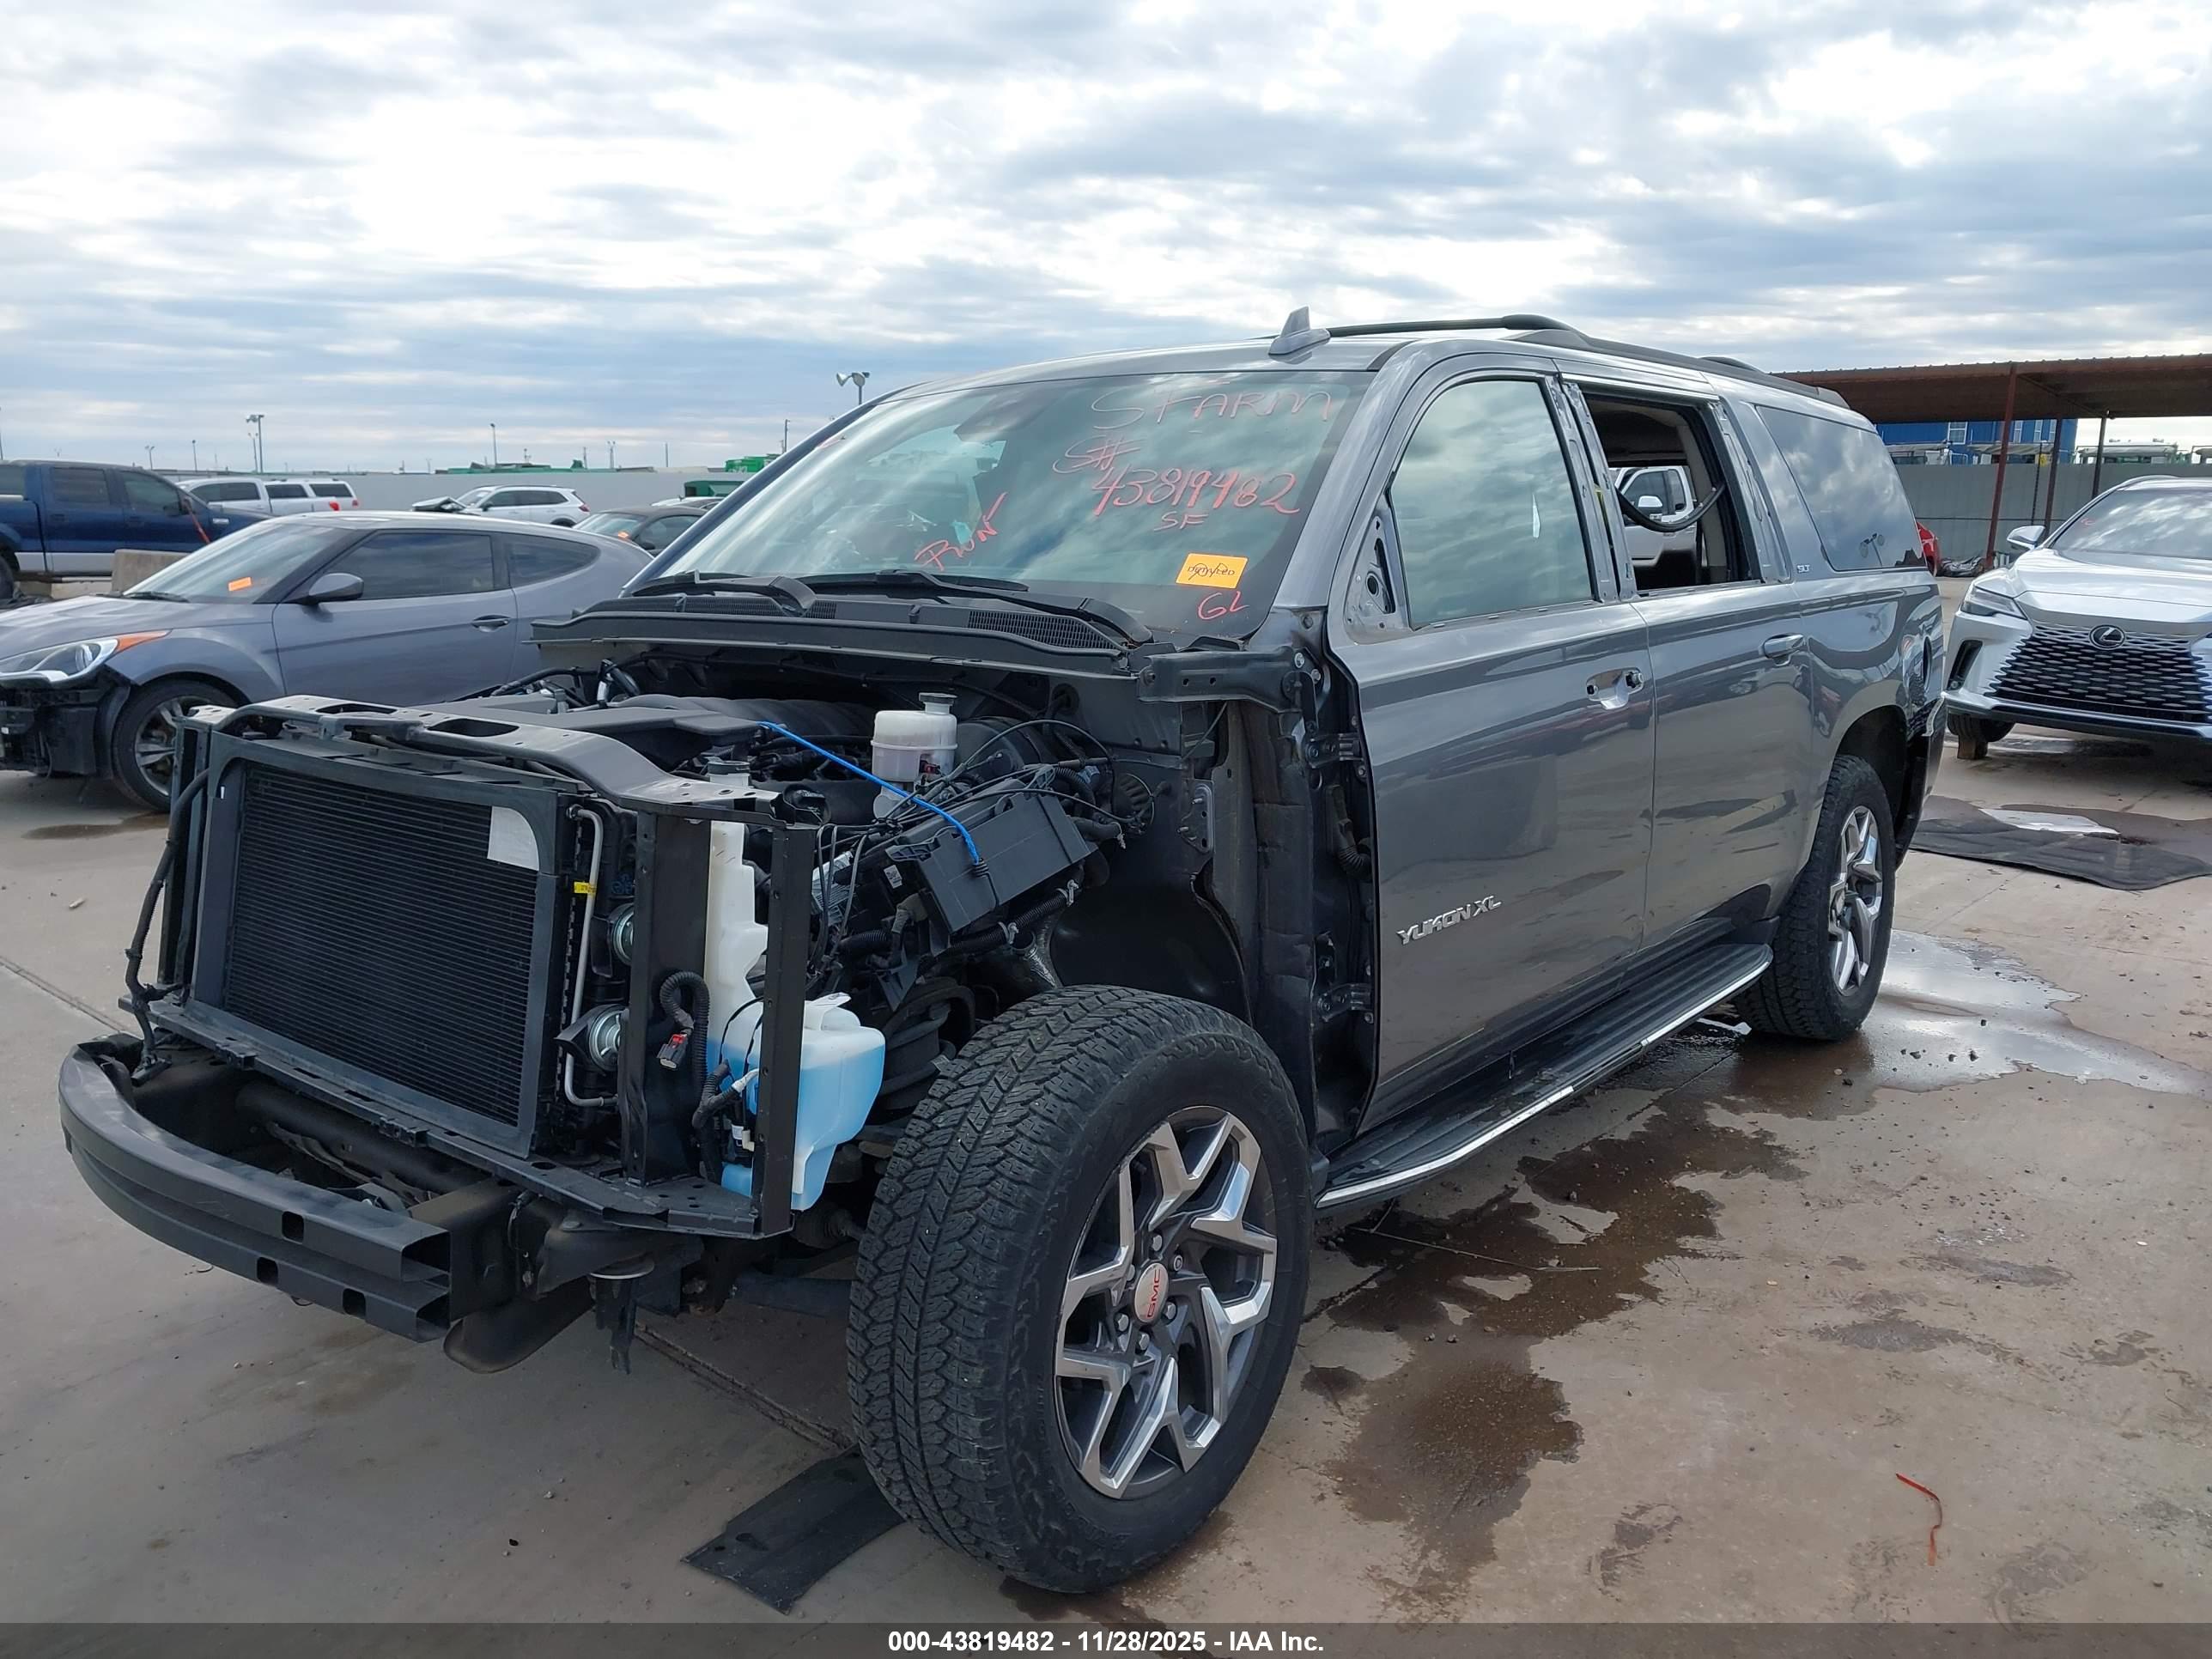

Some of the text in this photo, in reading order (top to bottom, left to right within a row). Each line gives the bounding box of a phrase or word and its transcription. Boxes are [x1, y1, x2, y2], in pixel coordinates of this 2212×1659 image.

[1091, 466, 1300, 516] 43819482
[1153, 511, 1209, 532] SF
[1396, 895, 1502, 945] YUKON XL
[1147, 1269, 1161, 1317] GMC
